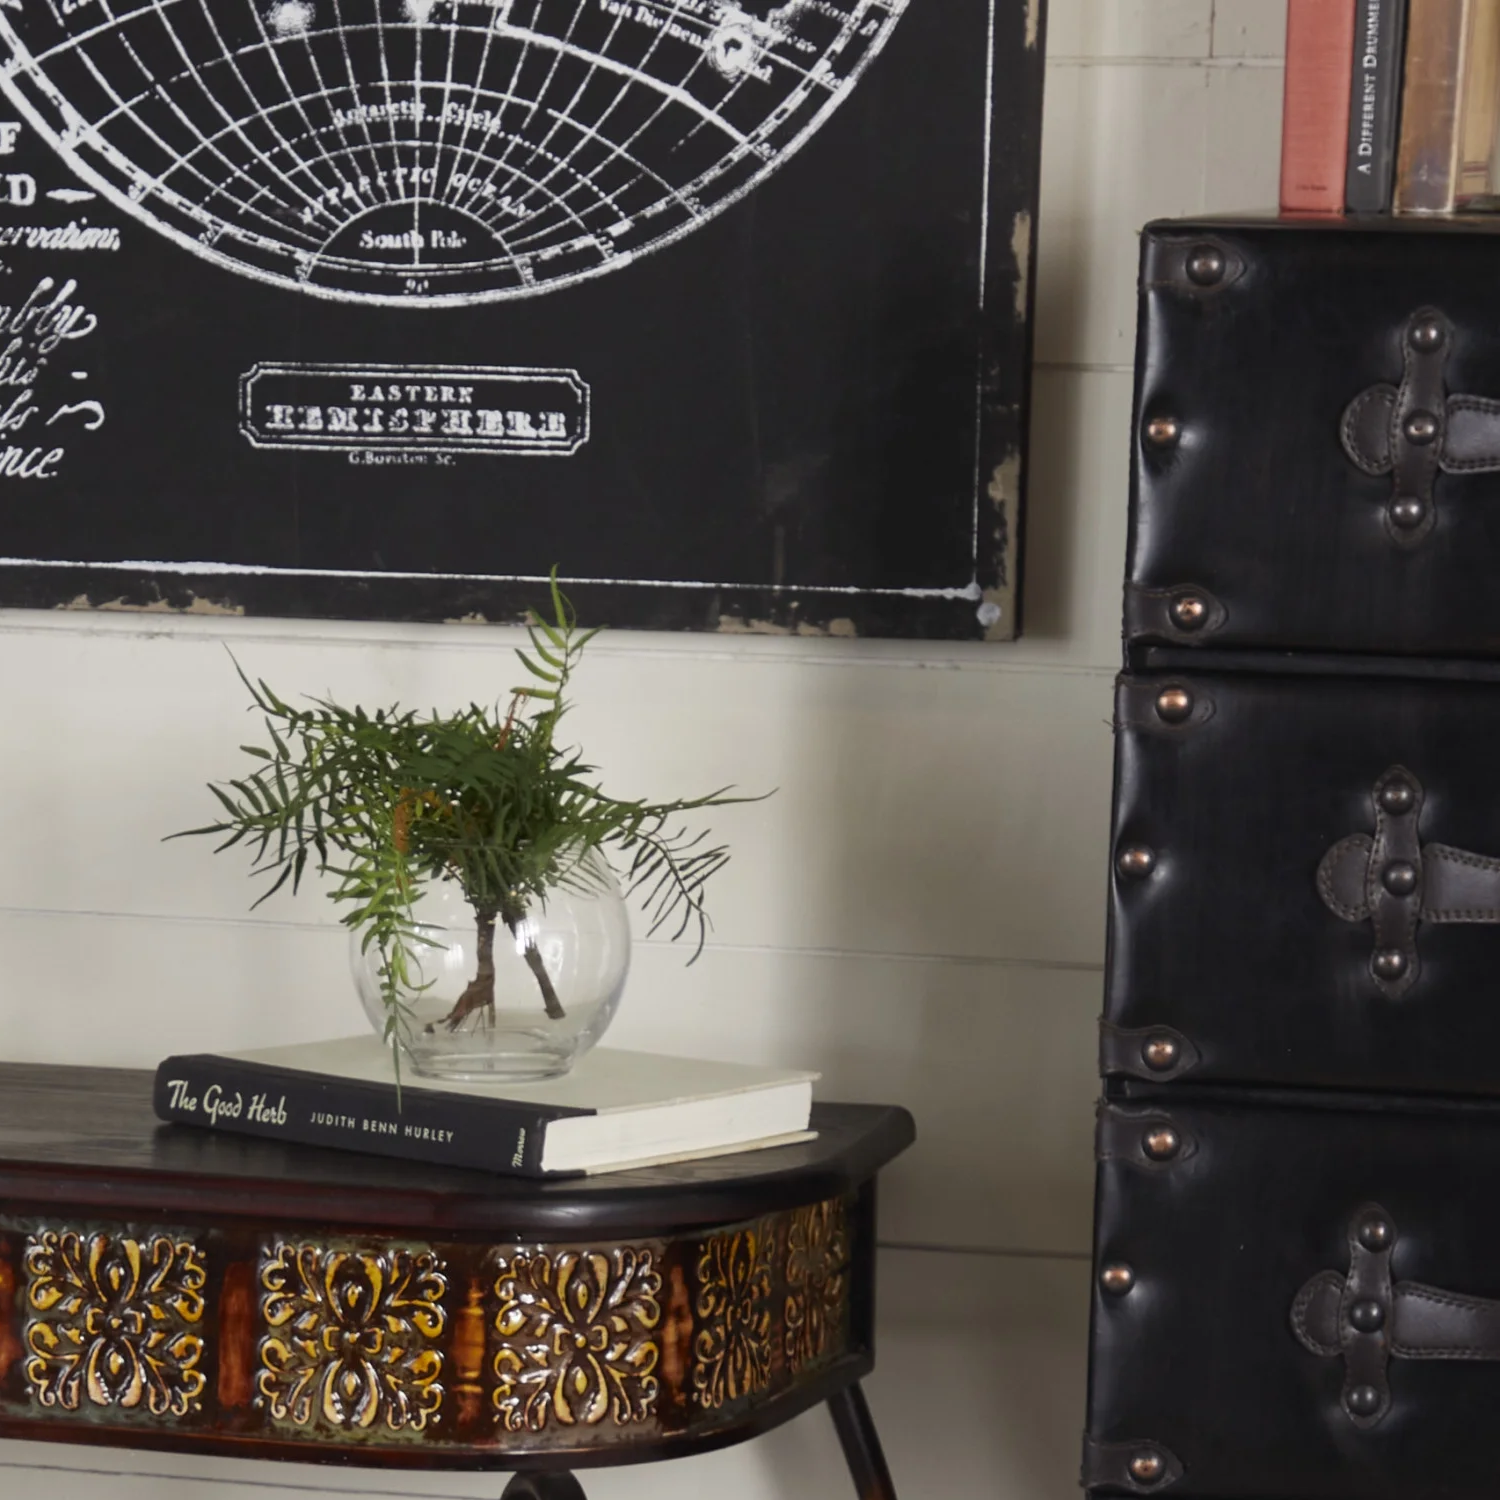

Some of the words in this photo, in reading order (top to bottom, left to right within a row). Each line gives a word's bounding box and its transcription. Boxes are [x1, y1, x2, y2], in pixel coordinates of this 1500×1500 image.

[1362, 0, 1381, 68] DRUMME
[359, 229, 425, 249] South
[349, 384, 474, 404] EASTERN
[264, 404, 567, 438] HEMISPHERE
[167, 1079, 197, 1112] The
[203, 1084, 243, 1125] Good
[246, 1092, 288, 1126] Herb
[309, 1111, 356, 1130] JUDITH
[362, 1118, 399, 1136] BENN
[404, 1123, 455, 1144] HURLEY
[510, 1127, 527, 1168] Morrow
